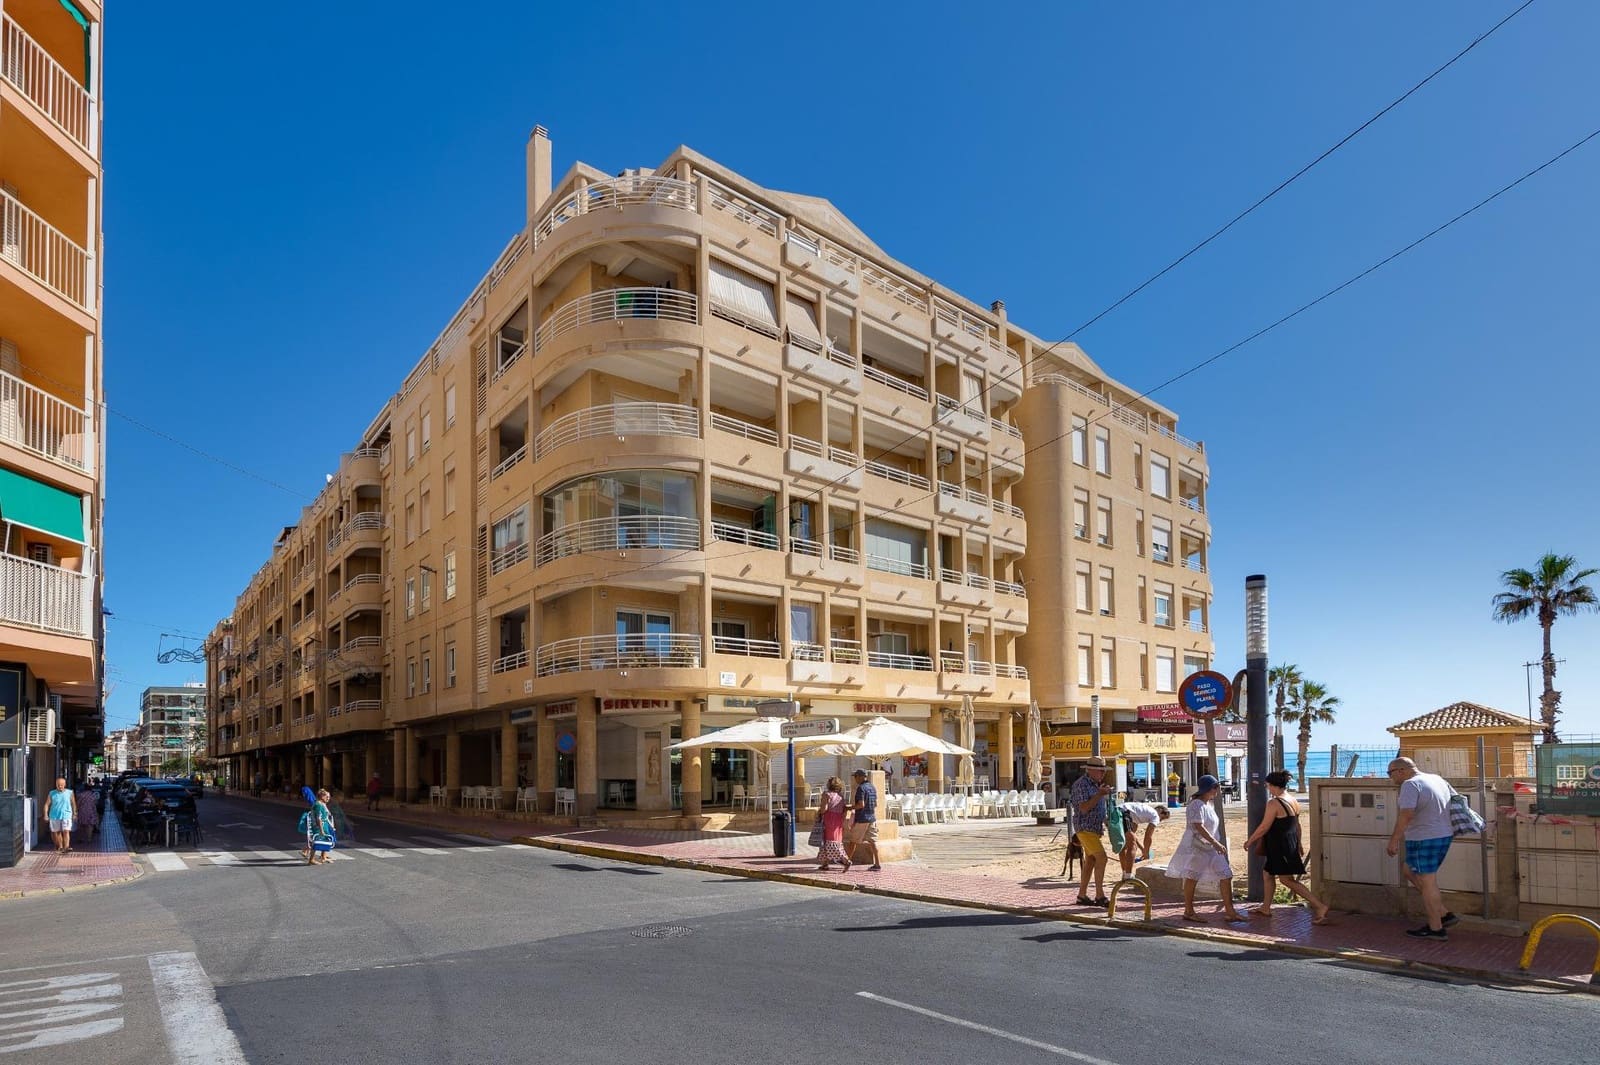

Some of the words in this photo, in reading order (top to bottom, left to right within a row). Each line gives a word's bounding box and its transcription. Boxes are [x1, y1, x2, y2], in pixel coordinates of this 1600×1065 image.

[603, 698, 670, 710] SIRVENT
[1141, 703, 1179, 711] RESTAURAN
[1049, 739, 1064, 750] Bar
[1066, 739, 1074, 749] el
